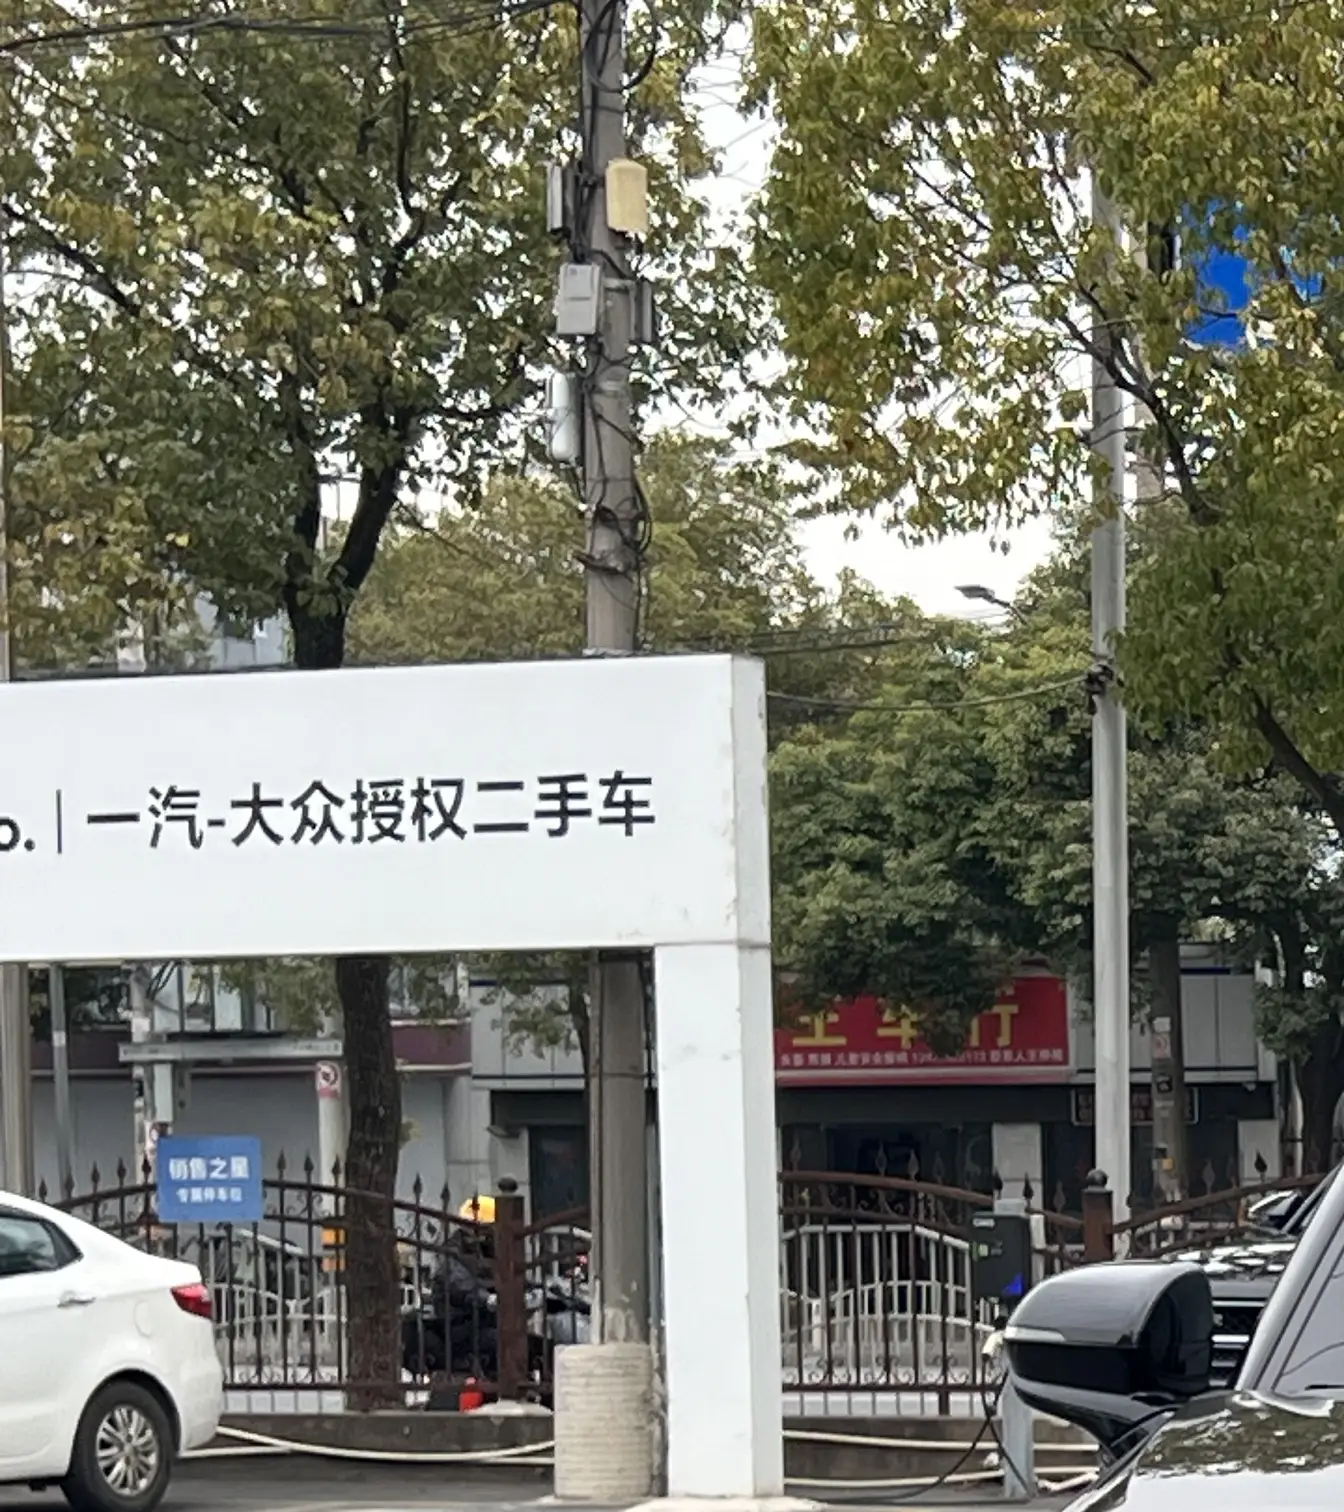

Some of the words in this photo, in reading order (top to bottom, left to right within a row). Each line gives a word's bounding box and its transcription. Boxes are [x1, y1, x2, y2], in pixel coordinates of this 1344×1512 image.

[87, 770, 656, 849] 一汽-大众授权二手车
